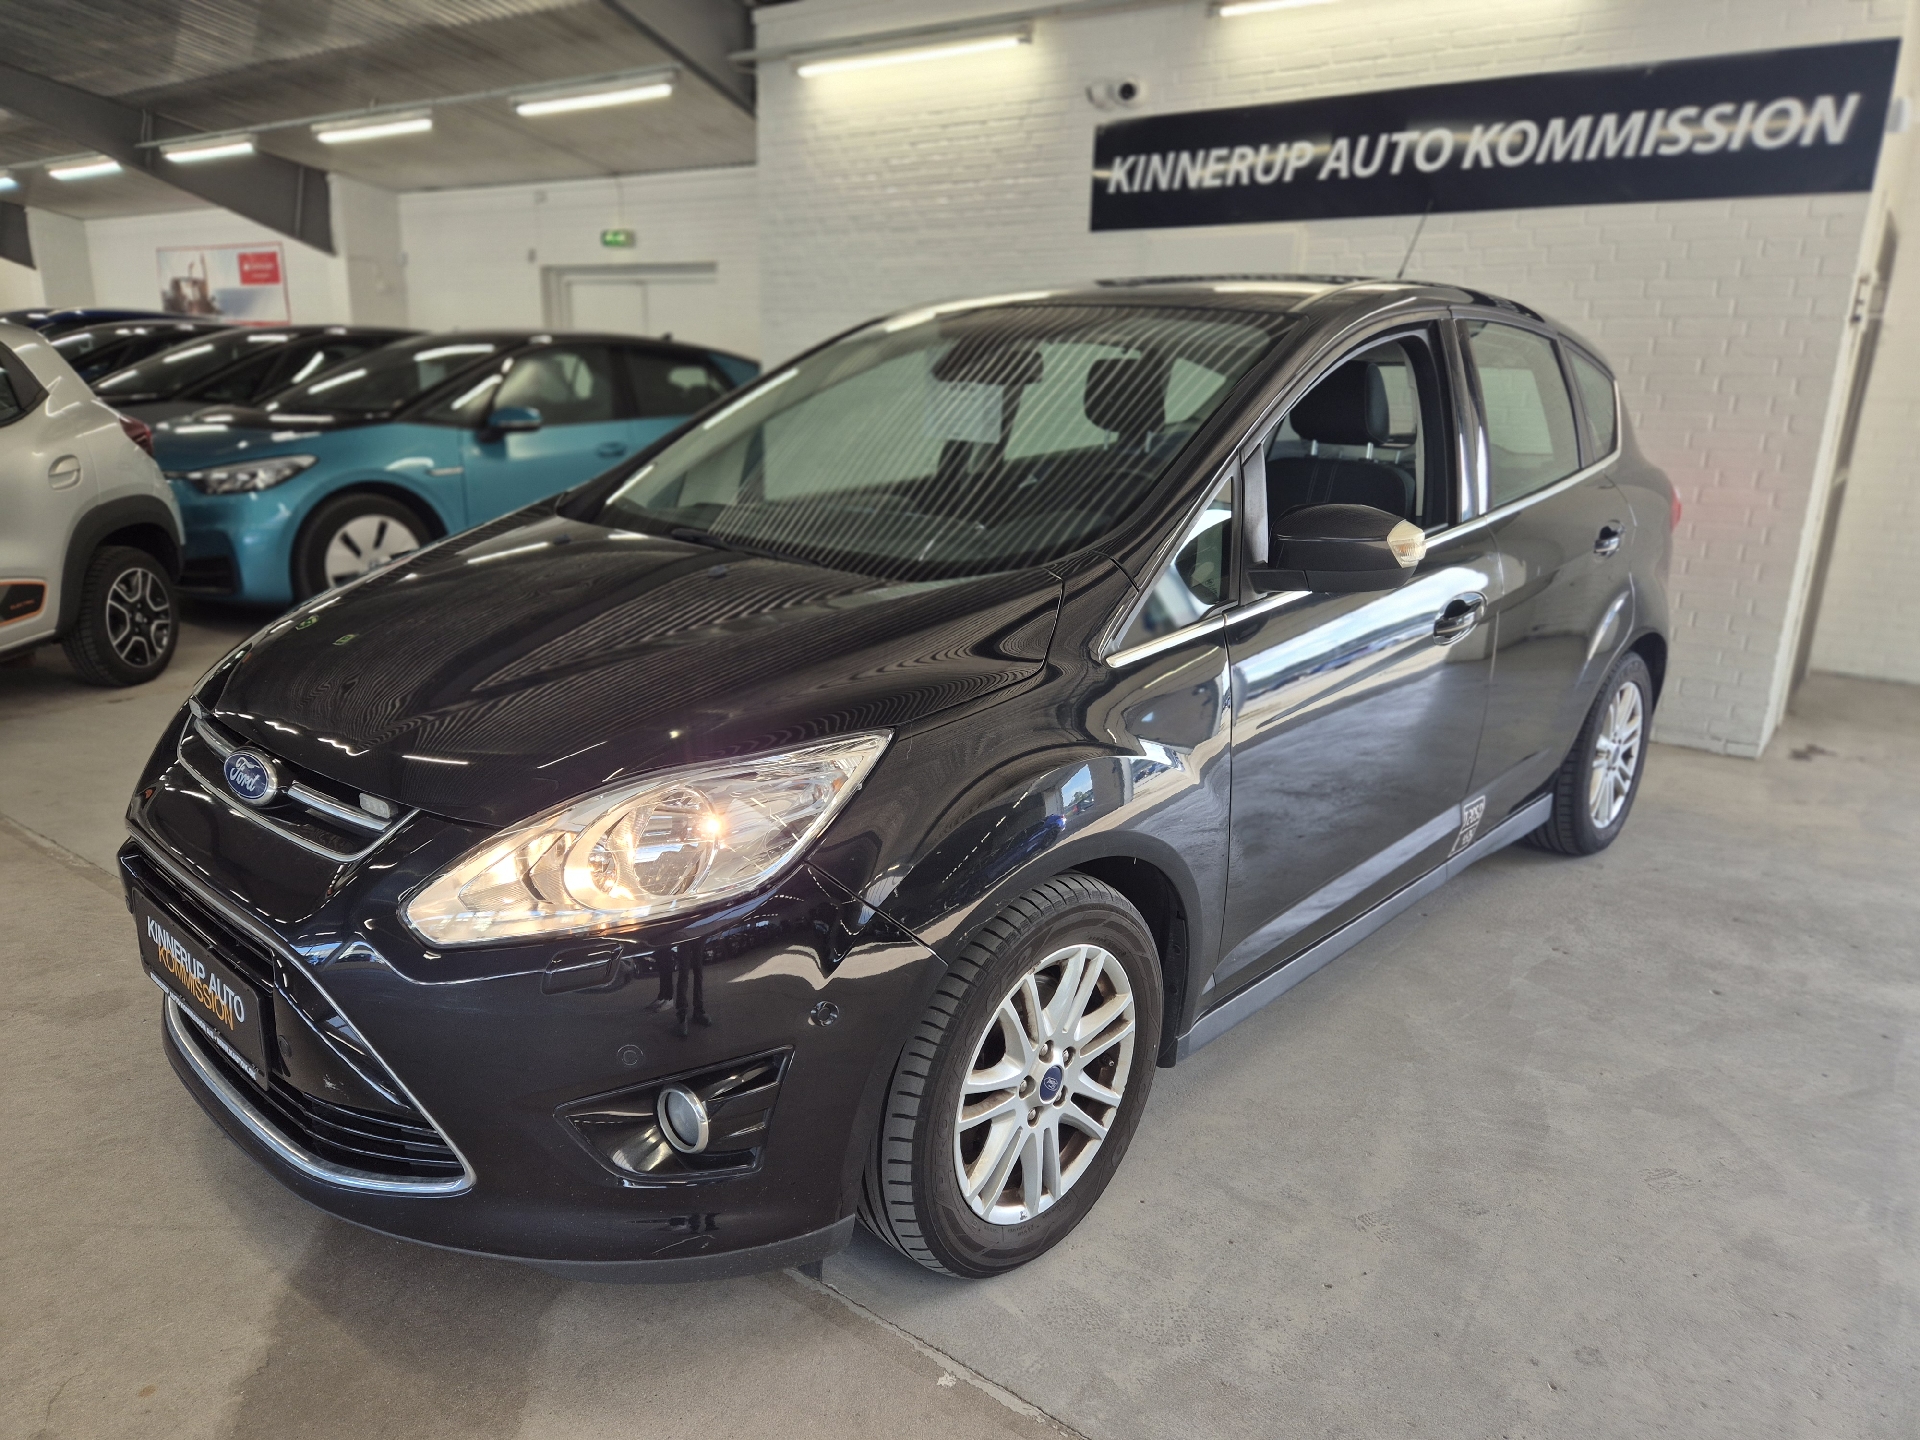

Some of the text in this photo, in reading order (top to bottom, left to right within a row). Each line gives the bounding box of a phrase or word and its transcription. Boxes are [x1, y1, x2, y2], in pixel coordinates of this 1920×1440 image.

[1106, 92, 1862, 194] KINNERUP AUTO KOMMISSION
[230, 756, 260, 791] Ford
[147, 915, 245, 1023] KINNERUP AUTO
[158, 943, 234, 1031] KOMMISSION
